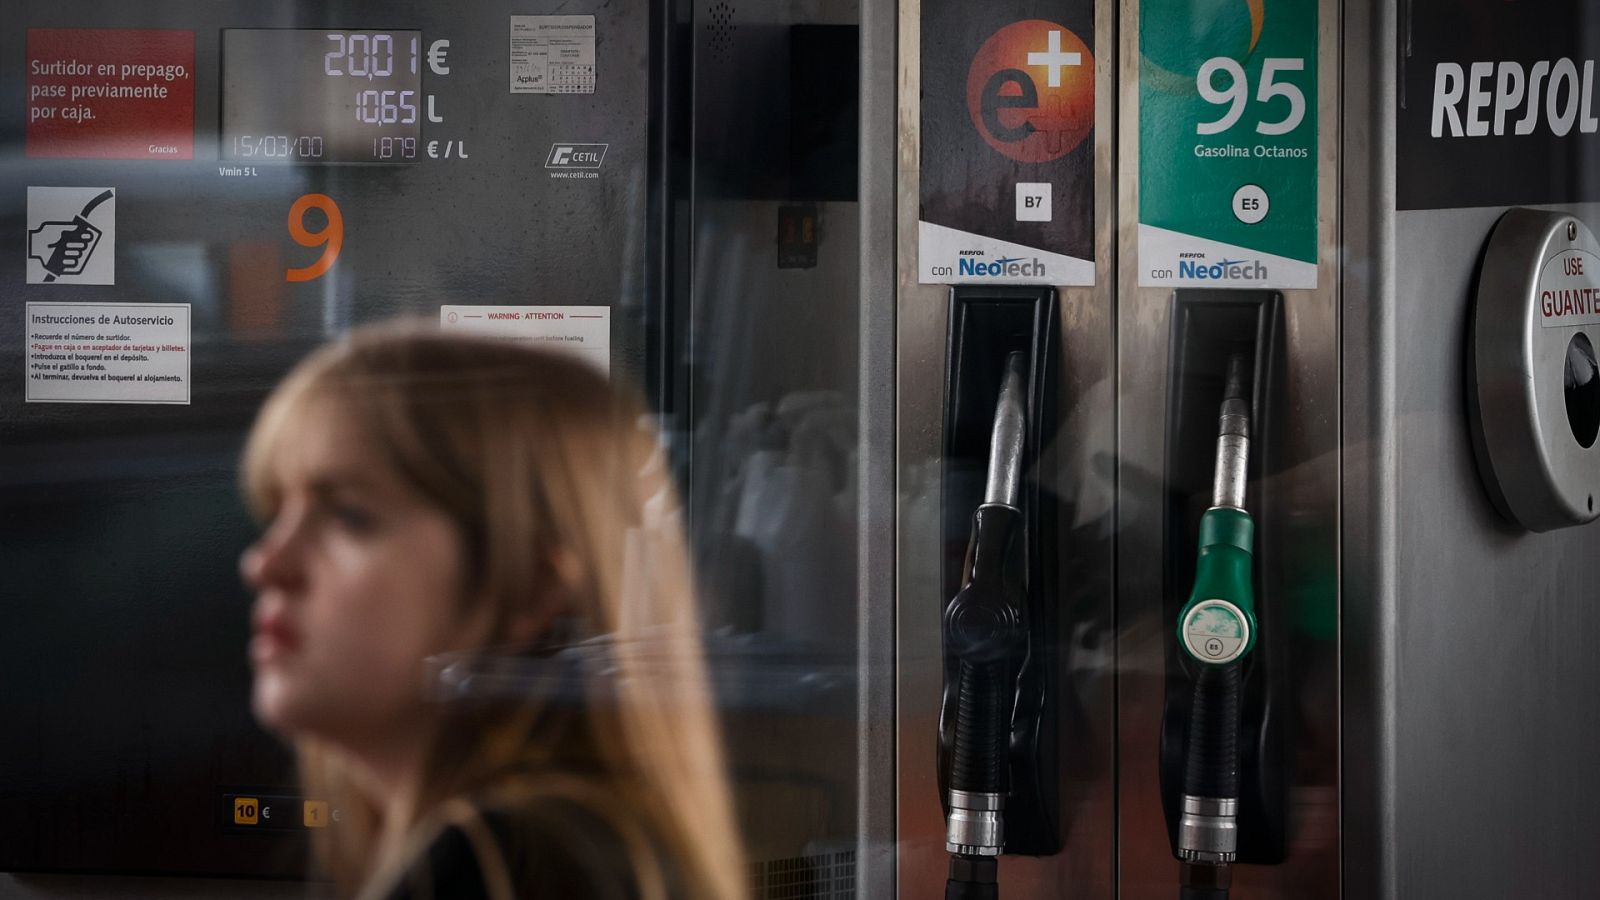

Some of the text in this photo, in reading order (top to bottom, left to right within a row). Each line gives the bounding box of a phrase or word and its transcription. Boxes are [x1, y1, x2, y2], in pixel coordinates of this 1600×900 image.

[427, 39, 450, 75] €
[31, 59, 189, 81] Surtidor en prepago,
[31, 83, 168, 102] pase previamente
[1195, 56, 1306, 136] 95
[1431, 57, 1599, 138] REPSOL
[31, 104, 96, 124] por caja.
[427, 95, 443, 123] L
[148, 144, 178, 154] Gracias
[1194, 144, 1308, 159] Gasolina Octanos
[572, 152, 599, 163] CETIL
[218, 167, 258, 177] Vmin 5 L
[550, 170, 599, 180] www.cetil.com
[1024, 196, 1042, 208] B7
[1242, 198, 1260, 210] E5
[286, 192, 344, 283] 9
[931, 256, 1046, 277] con NeoTech
[1151, 258, 1268, 280] con NeoTech
[1563, 257, 1584, 277] USE
[1541, 288, 1600, 318] GUANTE
[31, 313, 174, 326] Instrucciones de Autoservicio
[487, 312, 564, 320] WARNING ATTENTION
[34, 333, 132, 341] Recuerde el número de surtidor.
[34, 343, 53, 352] Pague
[63, 343, 76, 352] caja
[92, 344, 122, 353] aceptador
[123, 344, 131, 352] de
[132, 344, 155, 353] tarjetas
[162, 344, 186, 353] billetes.
[34, 353, 66, 361] Introduzca
[75, 353, 102, 362] boquerel
[34, 363, 51, 371] Pulse
[52, 363, 58, 371] el
[59, 363, 79, 372] gatillo
[86, 363, 106, 371] fondo.
[34, 373, 41, 381] Al
[71, 374, 99, 382] devuelva
[100, 374, 106, 382] el
[107, 374, 135, 383] boquerel
[144, 375, 183, 384] alojamiento.
[236, 804, 255, 818] 10
[262, 806, 271, 819] €
